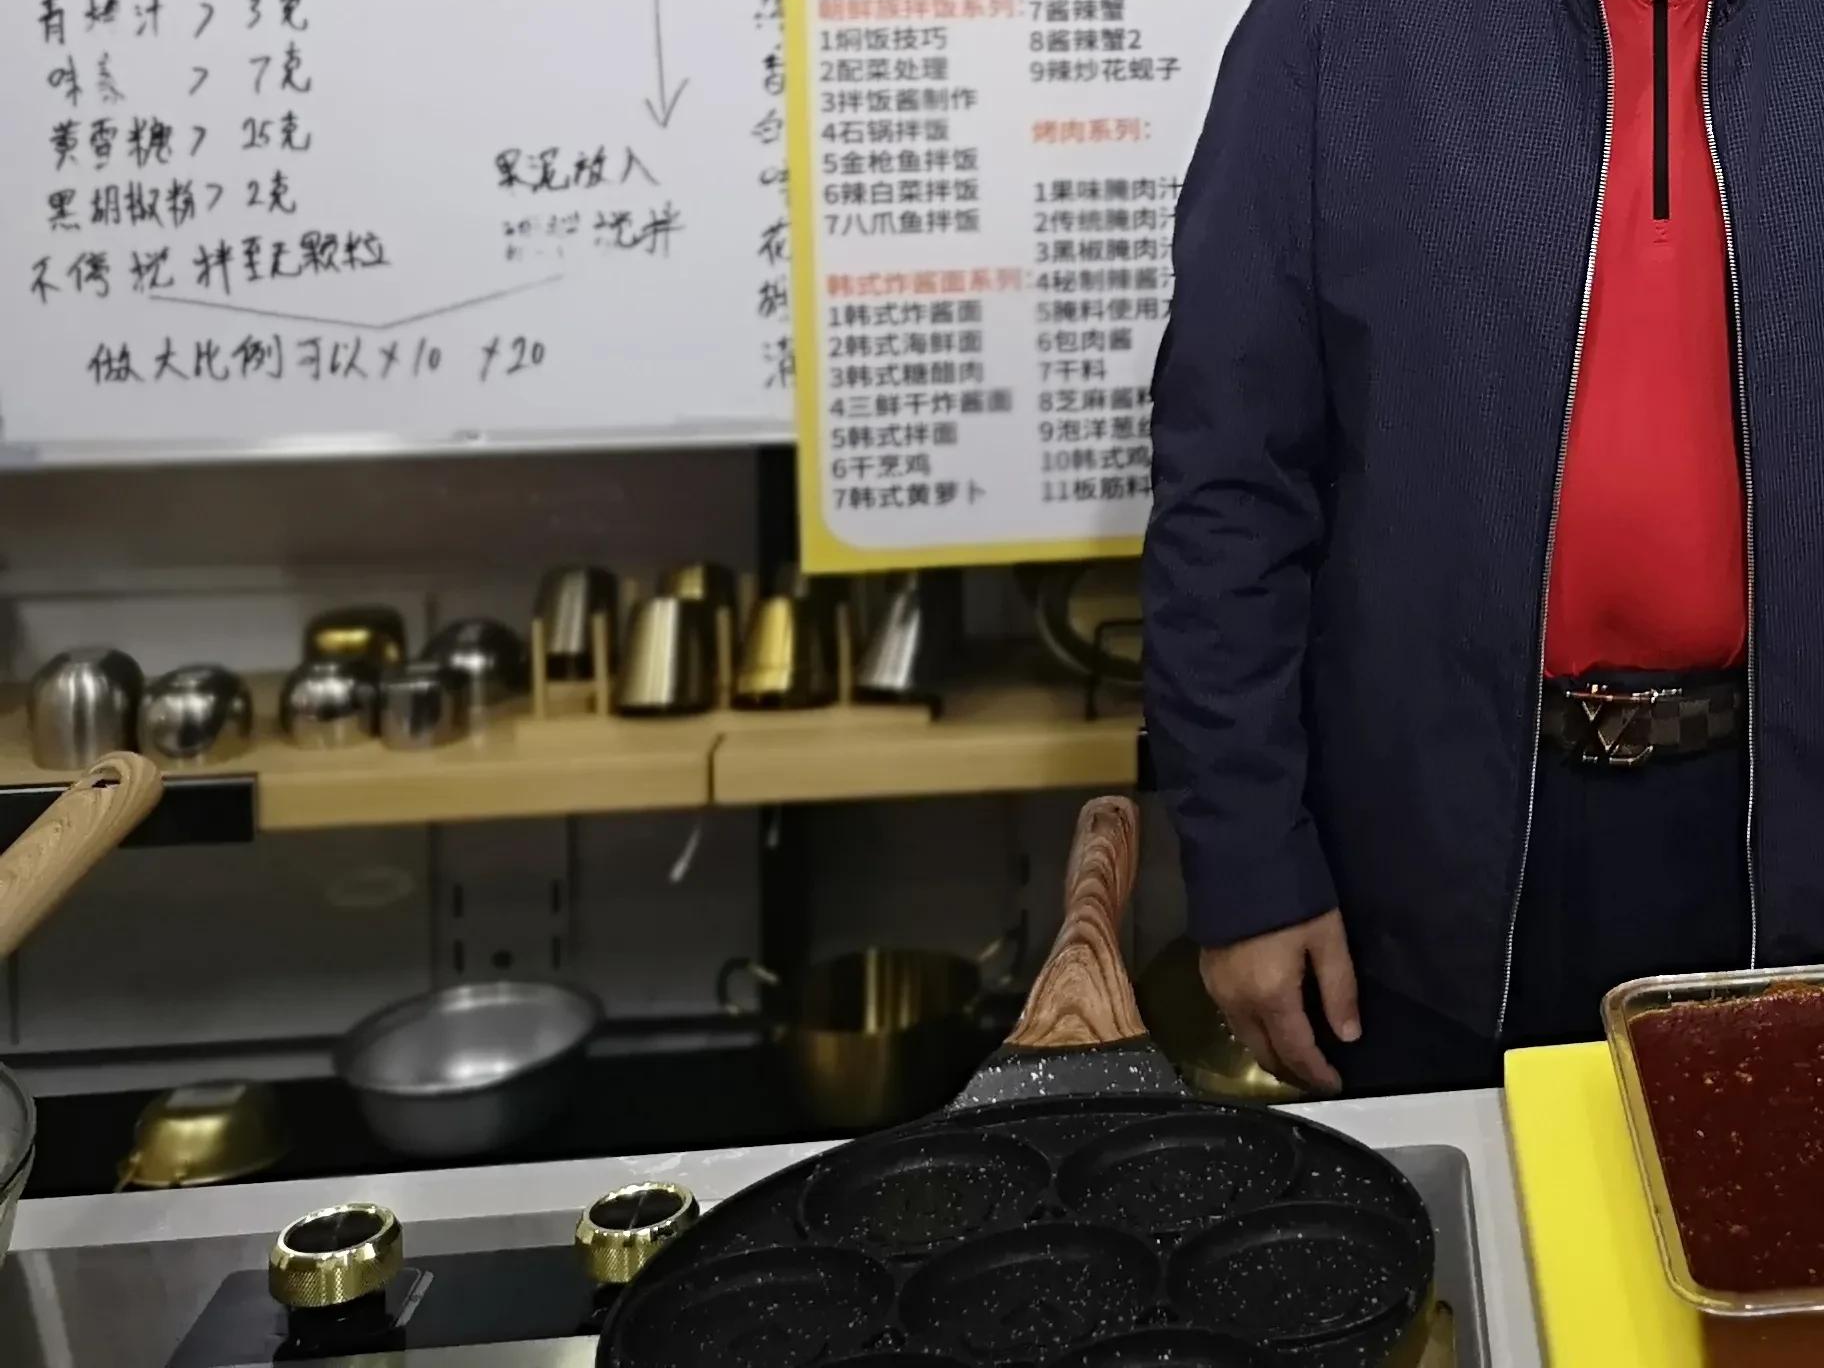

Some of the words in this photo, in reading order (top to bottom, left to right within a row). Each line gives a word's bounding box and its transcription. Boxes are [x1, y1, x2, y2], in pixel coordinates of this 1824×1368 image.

[819, 26, 948, 52] 1焖饭技巧
[1029, 28, 1142, 53] 8酱辣蟹2
[248, 39, 312, 94] 7克
[819, 56, 948, 83] 2配菜处理
[1029, 56, 1182, 83] 9辣炒花蚬子
[820, 86, 978, 114] 3拌饭酱制作
[821, 117, 950, 144] 4石锅拌饭
[822, 147, 979, 175] 5金枪鱼拌饭
[48, 178, 196, 231] 黑胡椒粉
[247, 169, 297, 215] 2克
[823, 178, 980, 206] 6辣白菜拌饭
[824, 208, 981, 236] 7八爪鱼拌饭
[828, 299, 982, 328] 1韩式炸酱面
[829, 329, 983, 358] 2韩式海鲜面
[1036, 327, 1132, 353] 6包肉酱
[829, 360, 984, 389] 3韩式糖醋肉
[1039, 357, 1106, 382] 7干料
[829, 387, 1013, 419] 4三鲜干炸酱面
[831, 420, 958, 449] 5韩式拌面
[832, 452, 931, 480] 6干烹鸡
[833, 479, 986, 510] 7韩式黄萝卜
